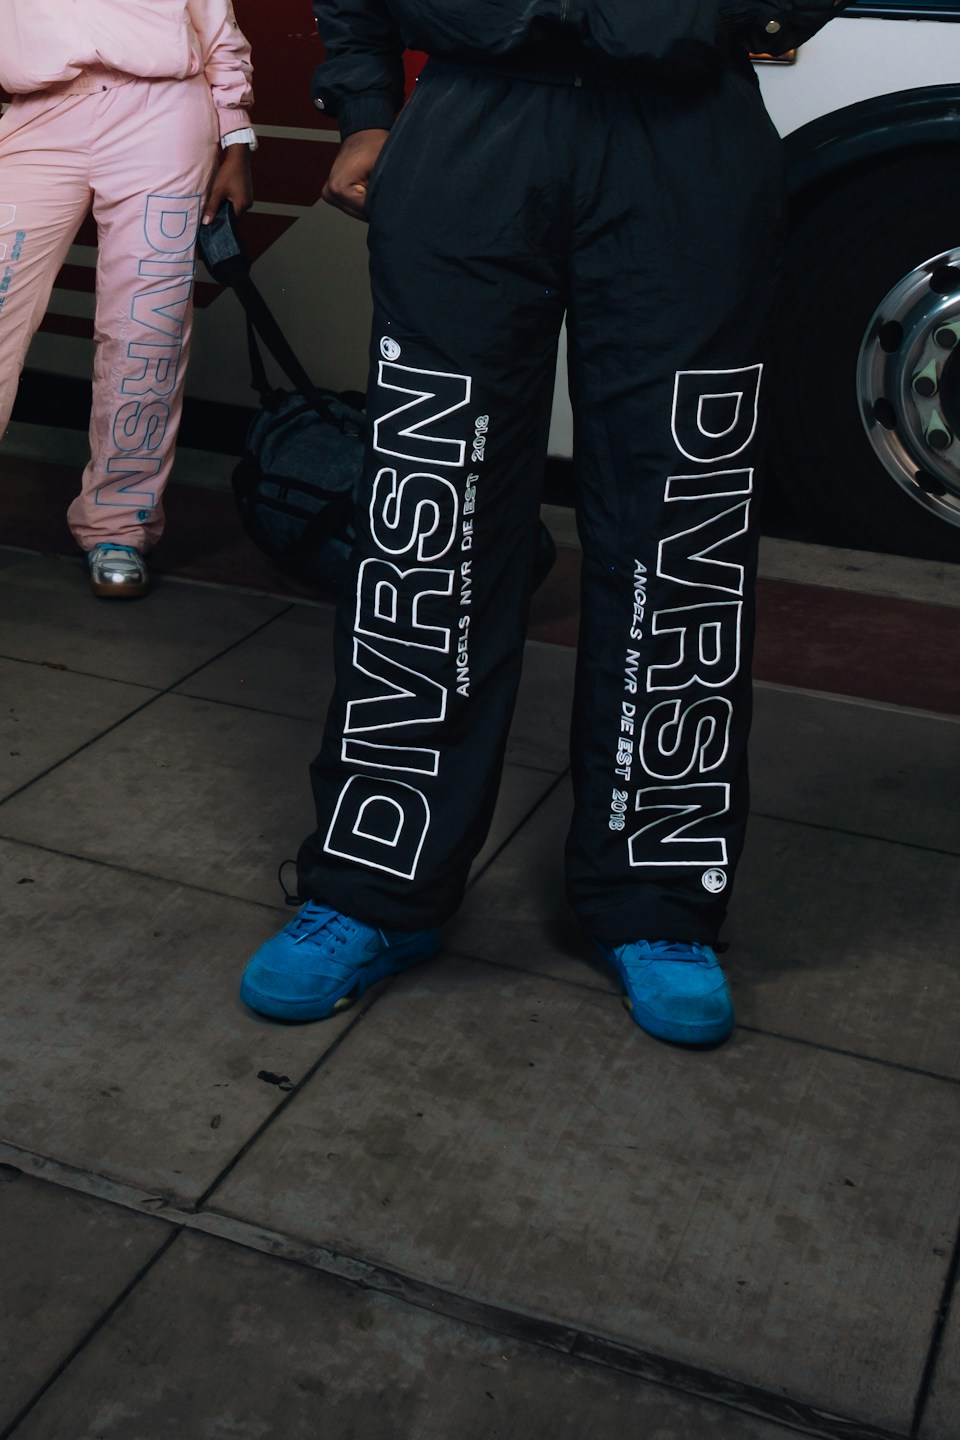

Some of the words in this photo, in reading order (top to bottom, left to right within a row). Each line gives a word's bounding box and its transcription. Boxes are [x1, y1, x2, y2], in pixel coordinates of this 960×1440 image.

[95, 194, 201, 509] DIVRSN
[471, 414, 489, 462] 2018
[463, 472, 480, 515] EST
[461, 519, 474, 551] DIE
[460, 560, 473, 605] NVR
[630, 559, 648, 640] ANGELS
[323, 360, 472, 881] DIVRSN
[628, 363, 763, 867] DIVRSN
[456, 615, 471, 698] ANGELS
[624, 648, 641, 694] NVR
[620, 701, 637, 735] DIE
[615, 737, 634, 781] EST
[608, 788, 629, 831] 2018
